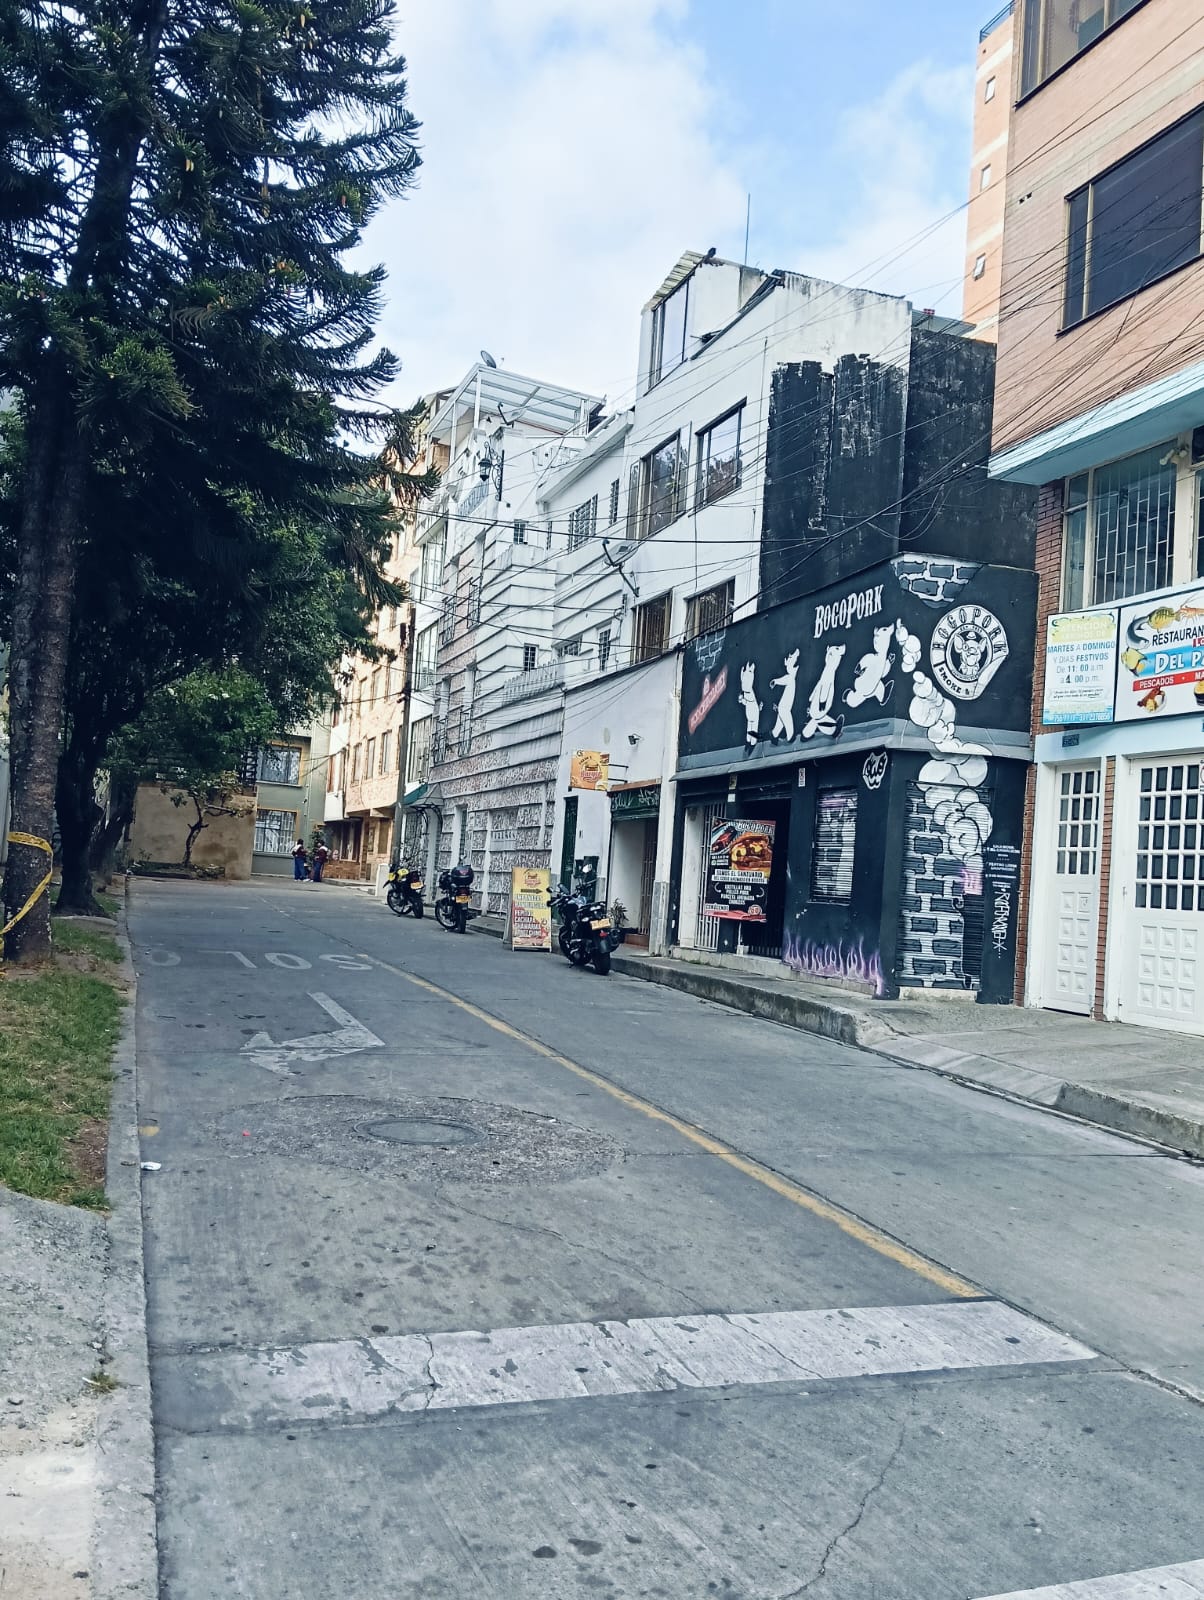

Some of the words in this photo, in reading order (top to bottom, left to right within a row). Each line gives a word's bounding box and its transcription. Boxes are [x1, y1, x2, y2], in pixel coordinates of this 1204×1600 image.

[1152, 624, 1204, 646] RESTAURAN
[1047, 644, 1074, 654] MARTES
[1082, 641, 1116, 650] DOMINGO
[1076, 652, 1109, 662] FESTIVOS
[1154, 653, 1185, 674] DEL
[938, 666, 962, 694] SMOKE
[1138, 676, 1174, 689] PESCADOS
[145, 950, 373, 970] SOLO
